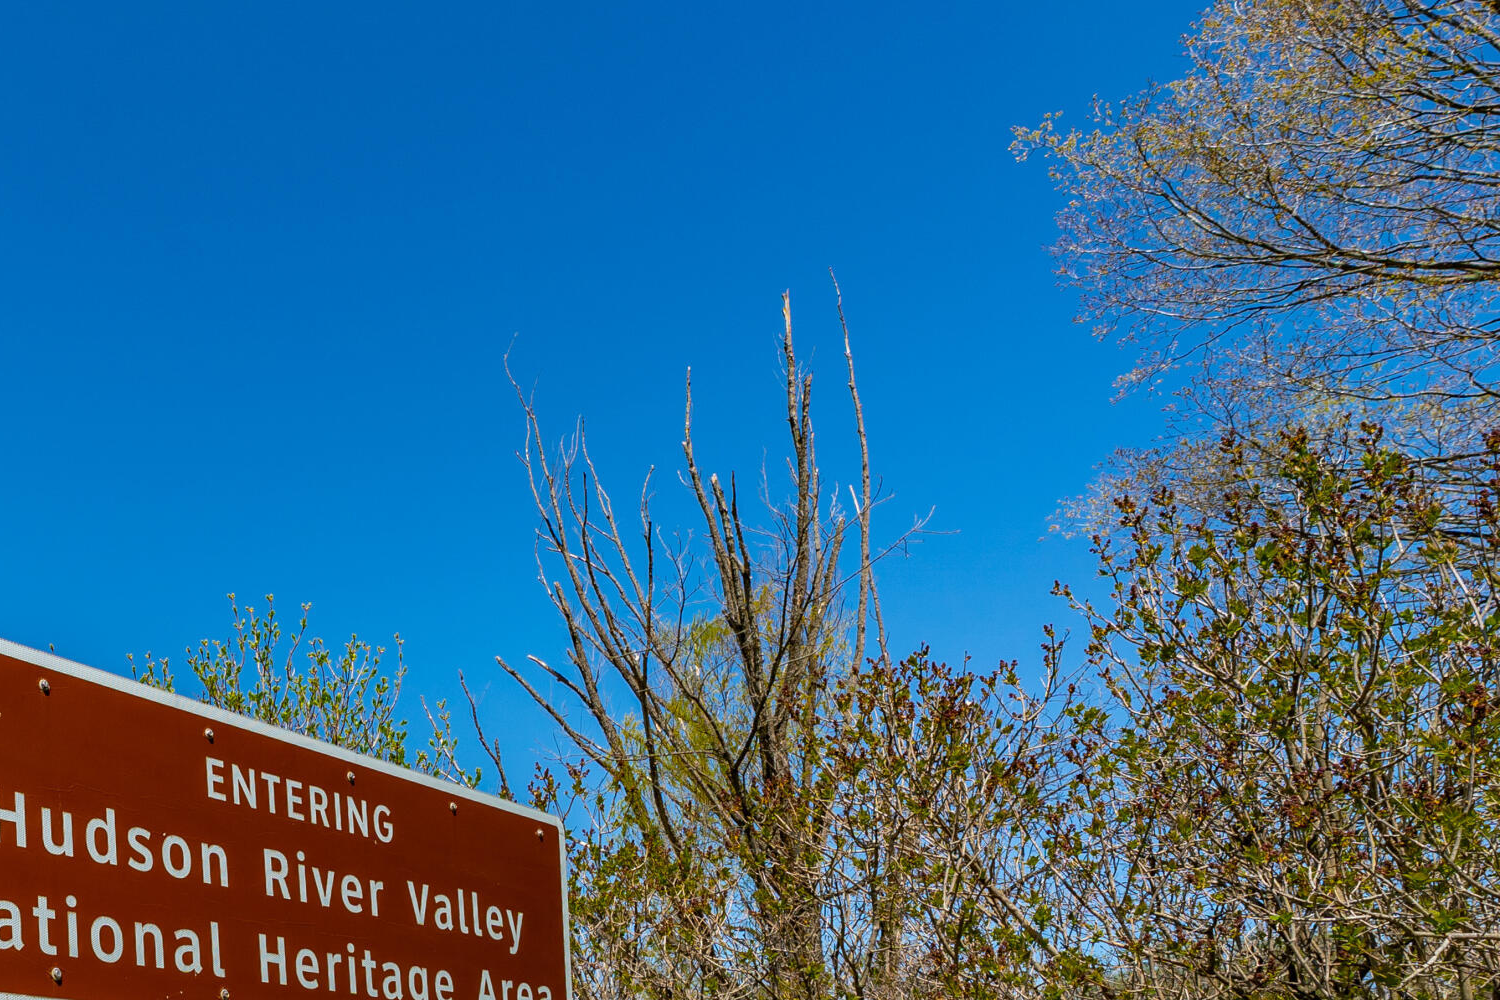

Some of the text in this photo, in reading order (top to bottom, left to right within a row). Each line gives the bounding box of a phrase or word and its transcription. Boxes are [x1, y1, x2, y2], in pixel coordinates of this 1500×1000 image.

[206, 756, 394, 844] ENTERING
[263, 848, 384, 918] River
[407, 880, 524, 955] Valley
